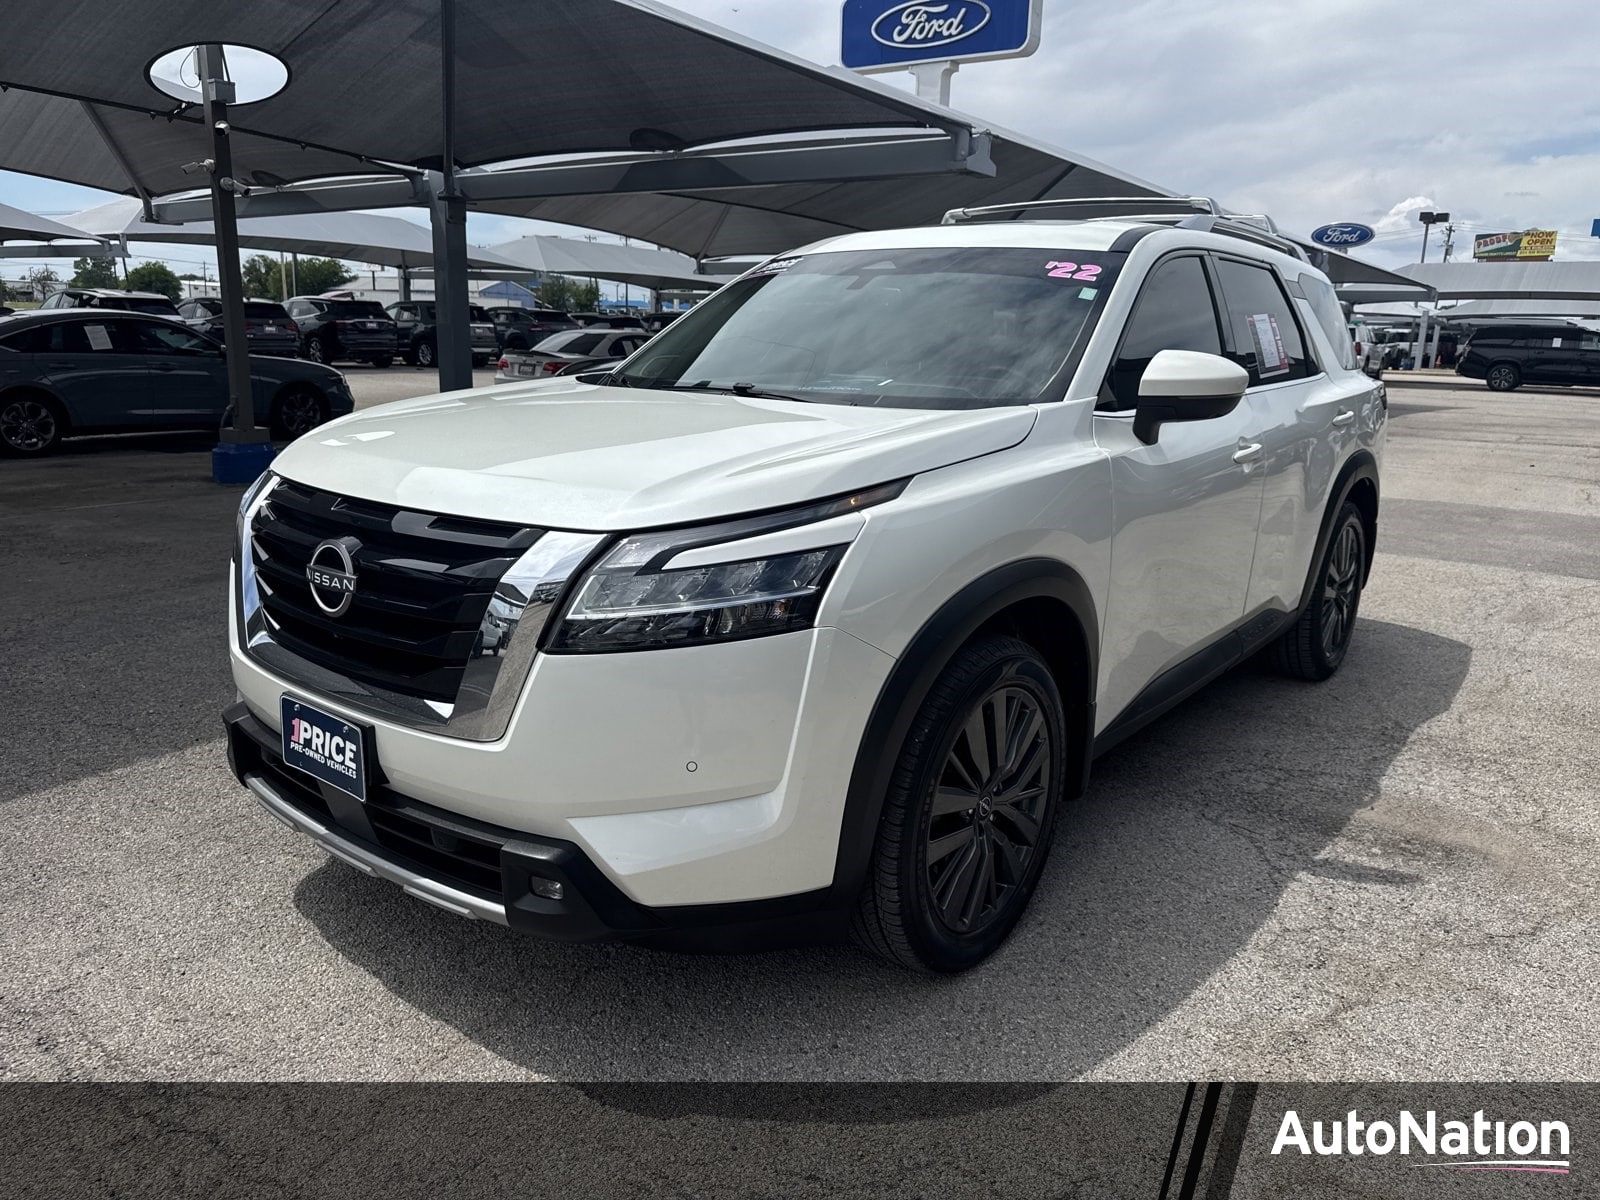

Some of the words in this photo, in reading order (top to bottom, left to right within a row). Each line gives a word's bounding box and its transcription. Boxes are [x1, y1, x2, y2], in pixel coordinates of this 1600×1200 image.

[892, 3, 967, 43] Ford
[1322, 227, 1361, 243] Ford
[1526, 238, 1554, 246] OPEN
[1530, 231, 1555, 239] NOW
[306, 567, 354, 591] NISSAN
[290, 741, 326, 764] PRE-OWNED
[326, 758, 357, 779] VEHICLES
